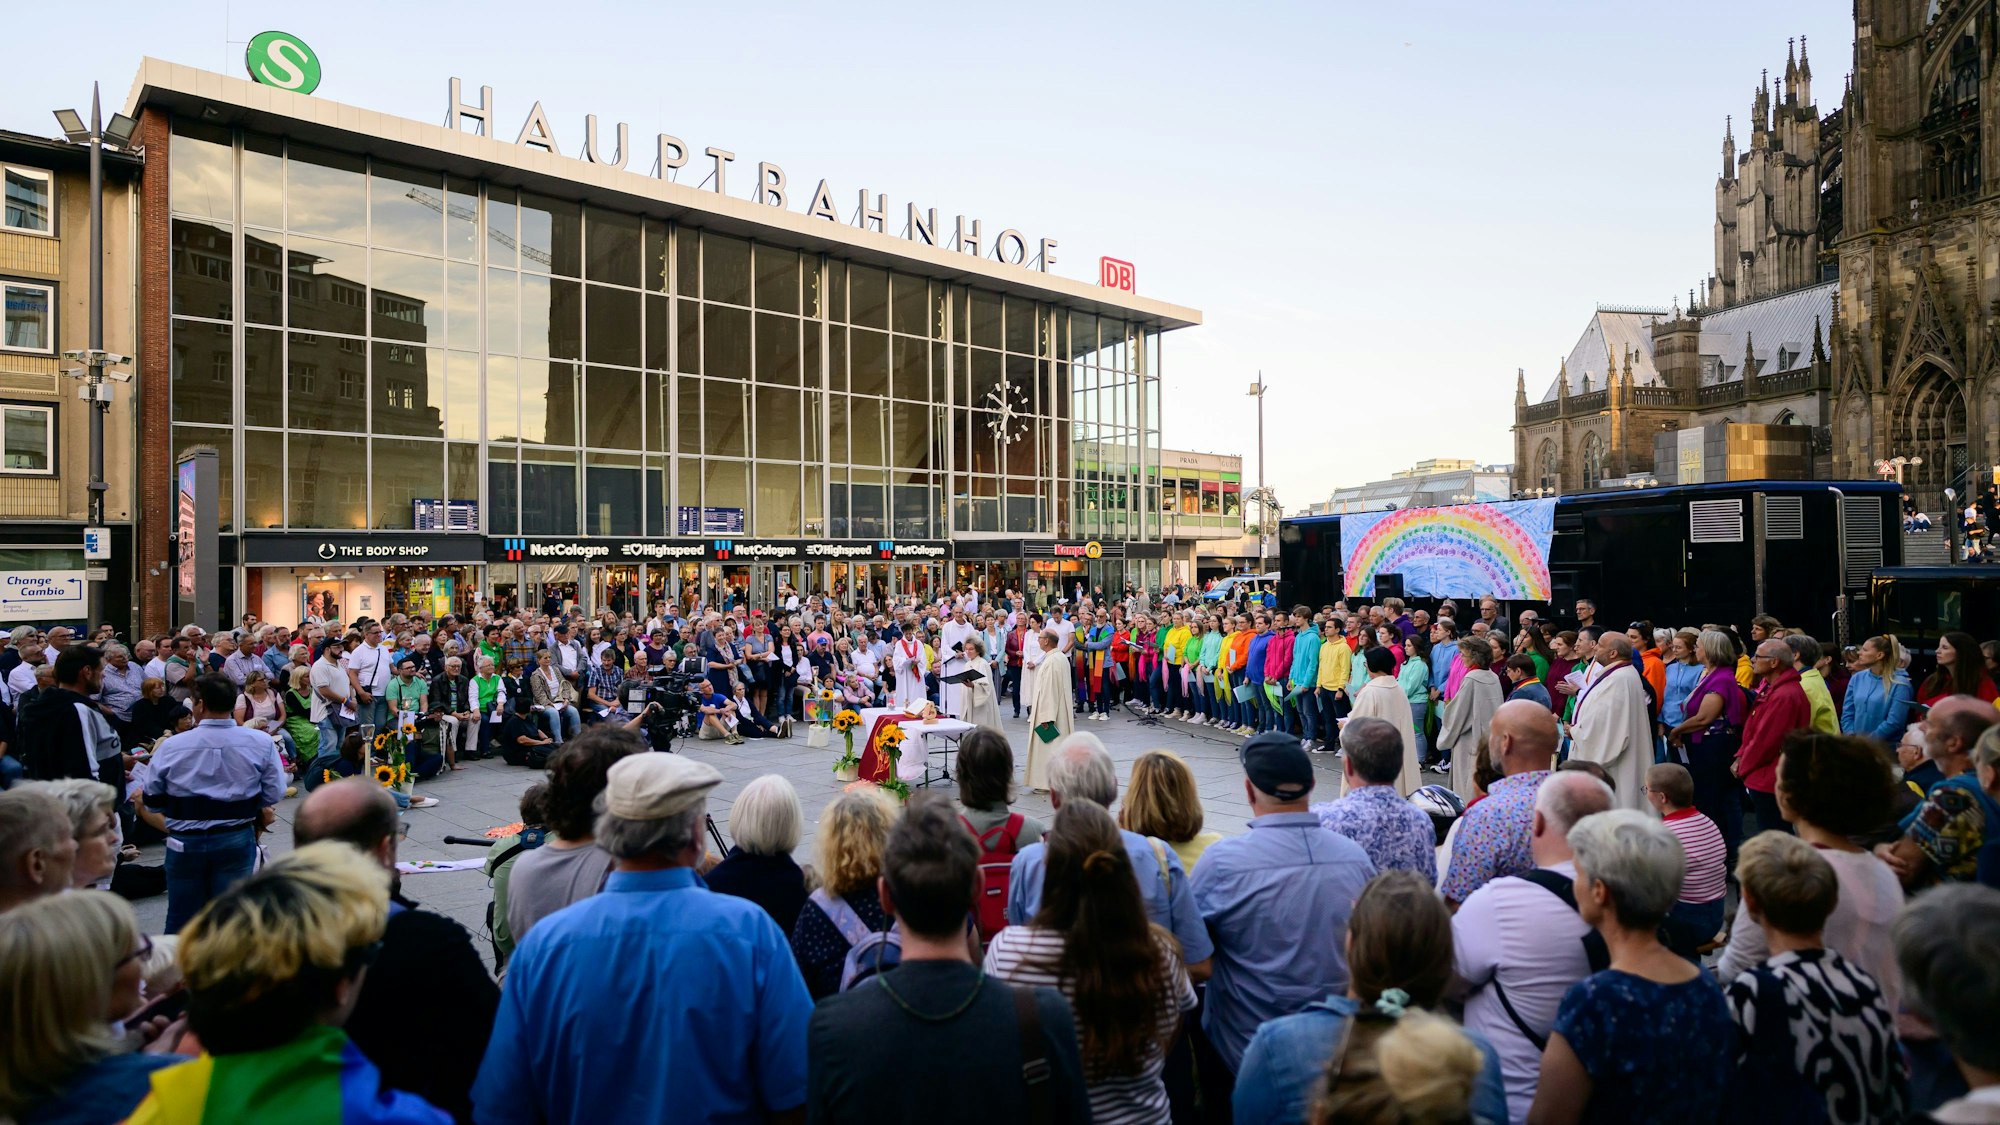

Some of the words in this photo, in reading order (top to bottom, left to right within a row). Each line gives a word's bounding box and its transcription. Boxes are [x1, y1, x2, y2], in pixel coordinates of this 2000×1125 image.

[260, 39, 309, 89] S
[447, 76, 1058, 275] HAUPTBAHNHOF
[1105, 262, 1132, 291] DB
[1179, 457, 1199, 465] PRADA
[340, 546, 362, 556] THE
[366, 546, 397, 556] BODY
[399, 546, 429, 556] SHOP
[529, 543, 610, 558] NetCologne
[642, 544, 705, 558] Highspeed
[734, 544, 797, 557] NetCologne
[823, 544, 872, 557] Highspeed
[894, 544, 946, 556] NetCologne
[1054, 544, 1087, 558] Kamps
[7, 576, 52, 587] Change
[21, 587, 65, 596] Cambio
